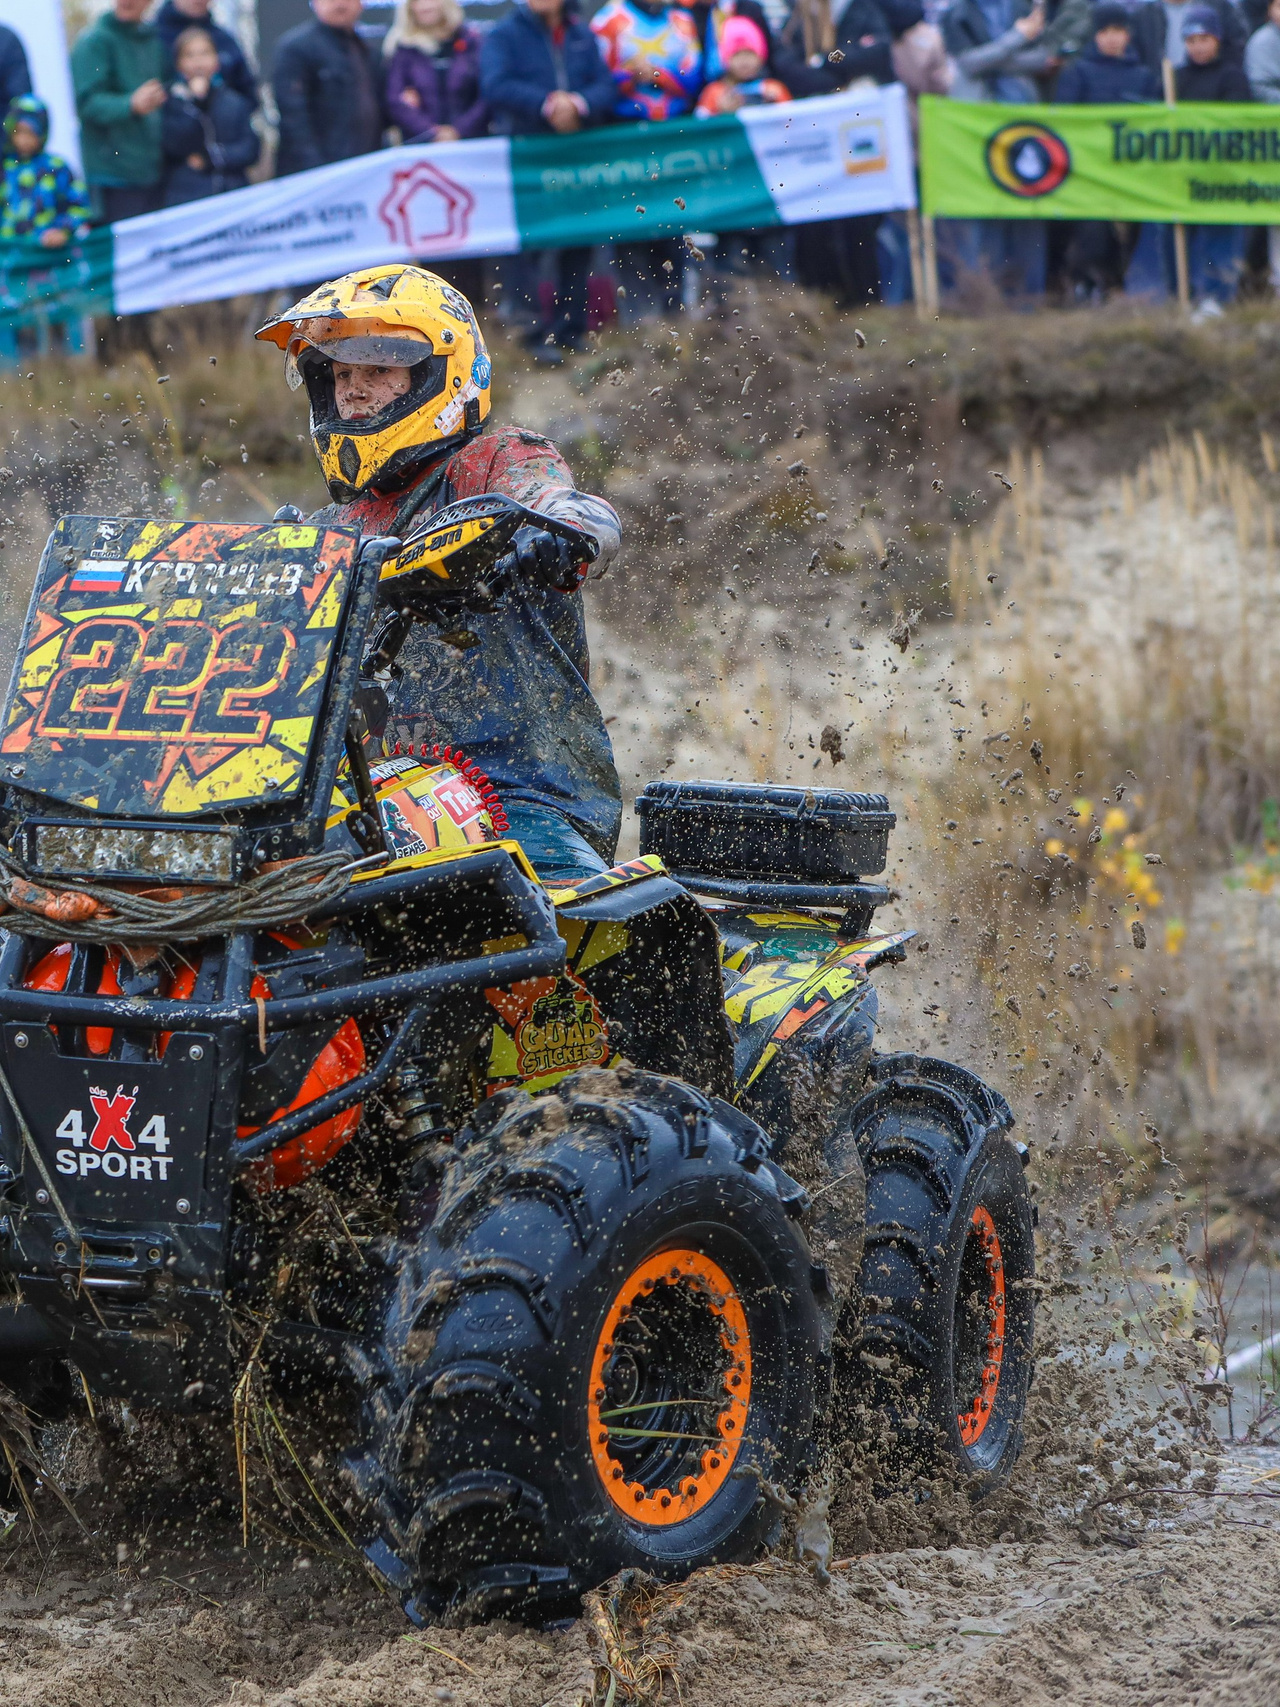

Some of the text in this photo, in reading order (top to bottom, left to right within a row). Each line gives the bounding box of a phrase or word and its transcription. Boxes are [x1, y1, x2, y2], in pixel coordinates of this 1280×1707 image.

[34, 617, 297, 745] 222
[521, 1021, 601, 1053] QUAD
[523, 1044, 603, 1074] STICKERS
[55, 1149, 174, 1182] SPORT
